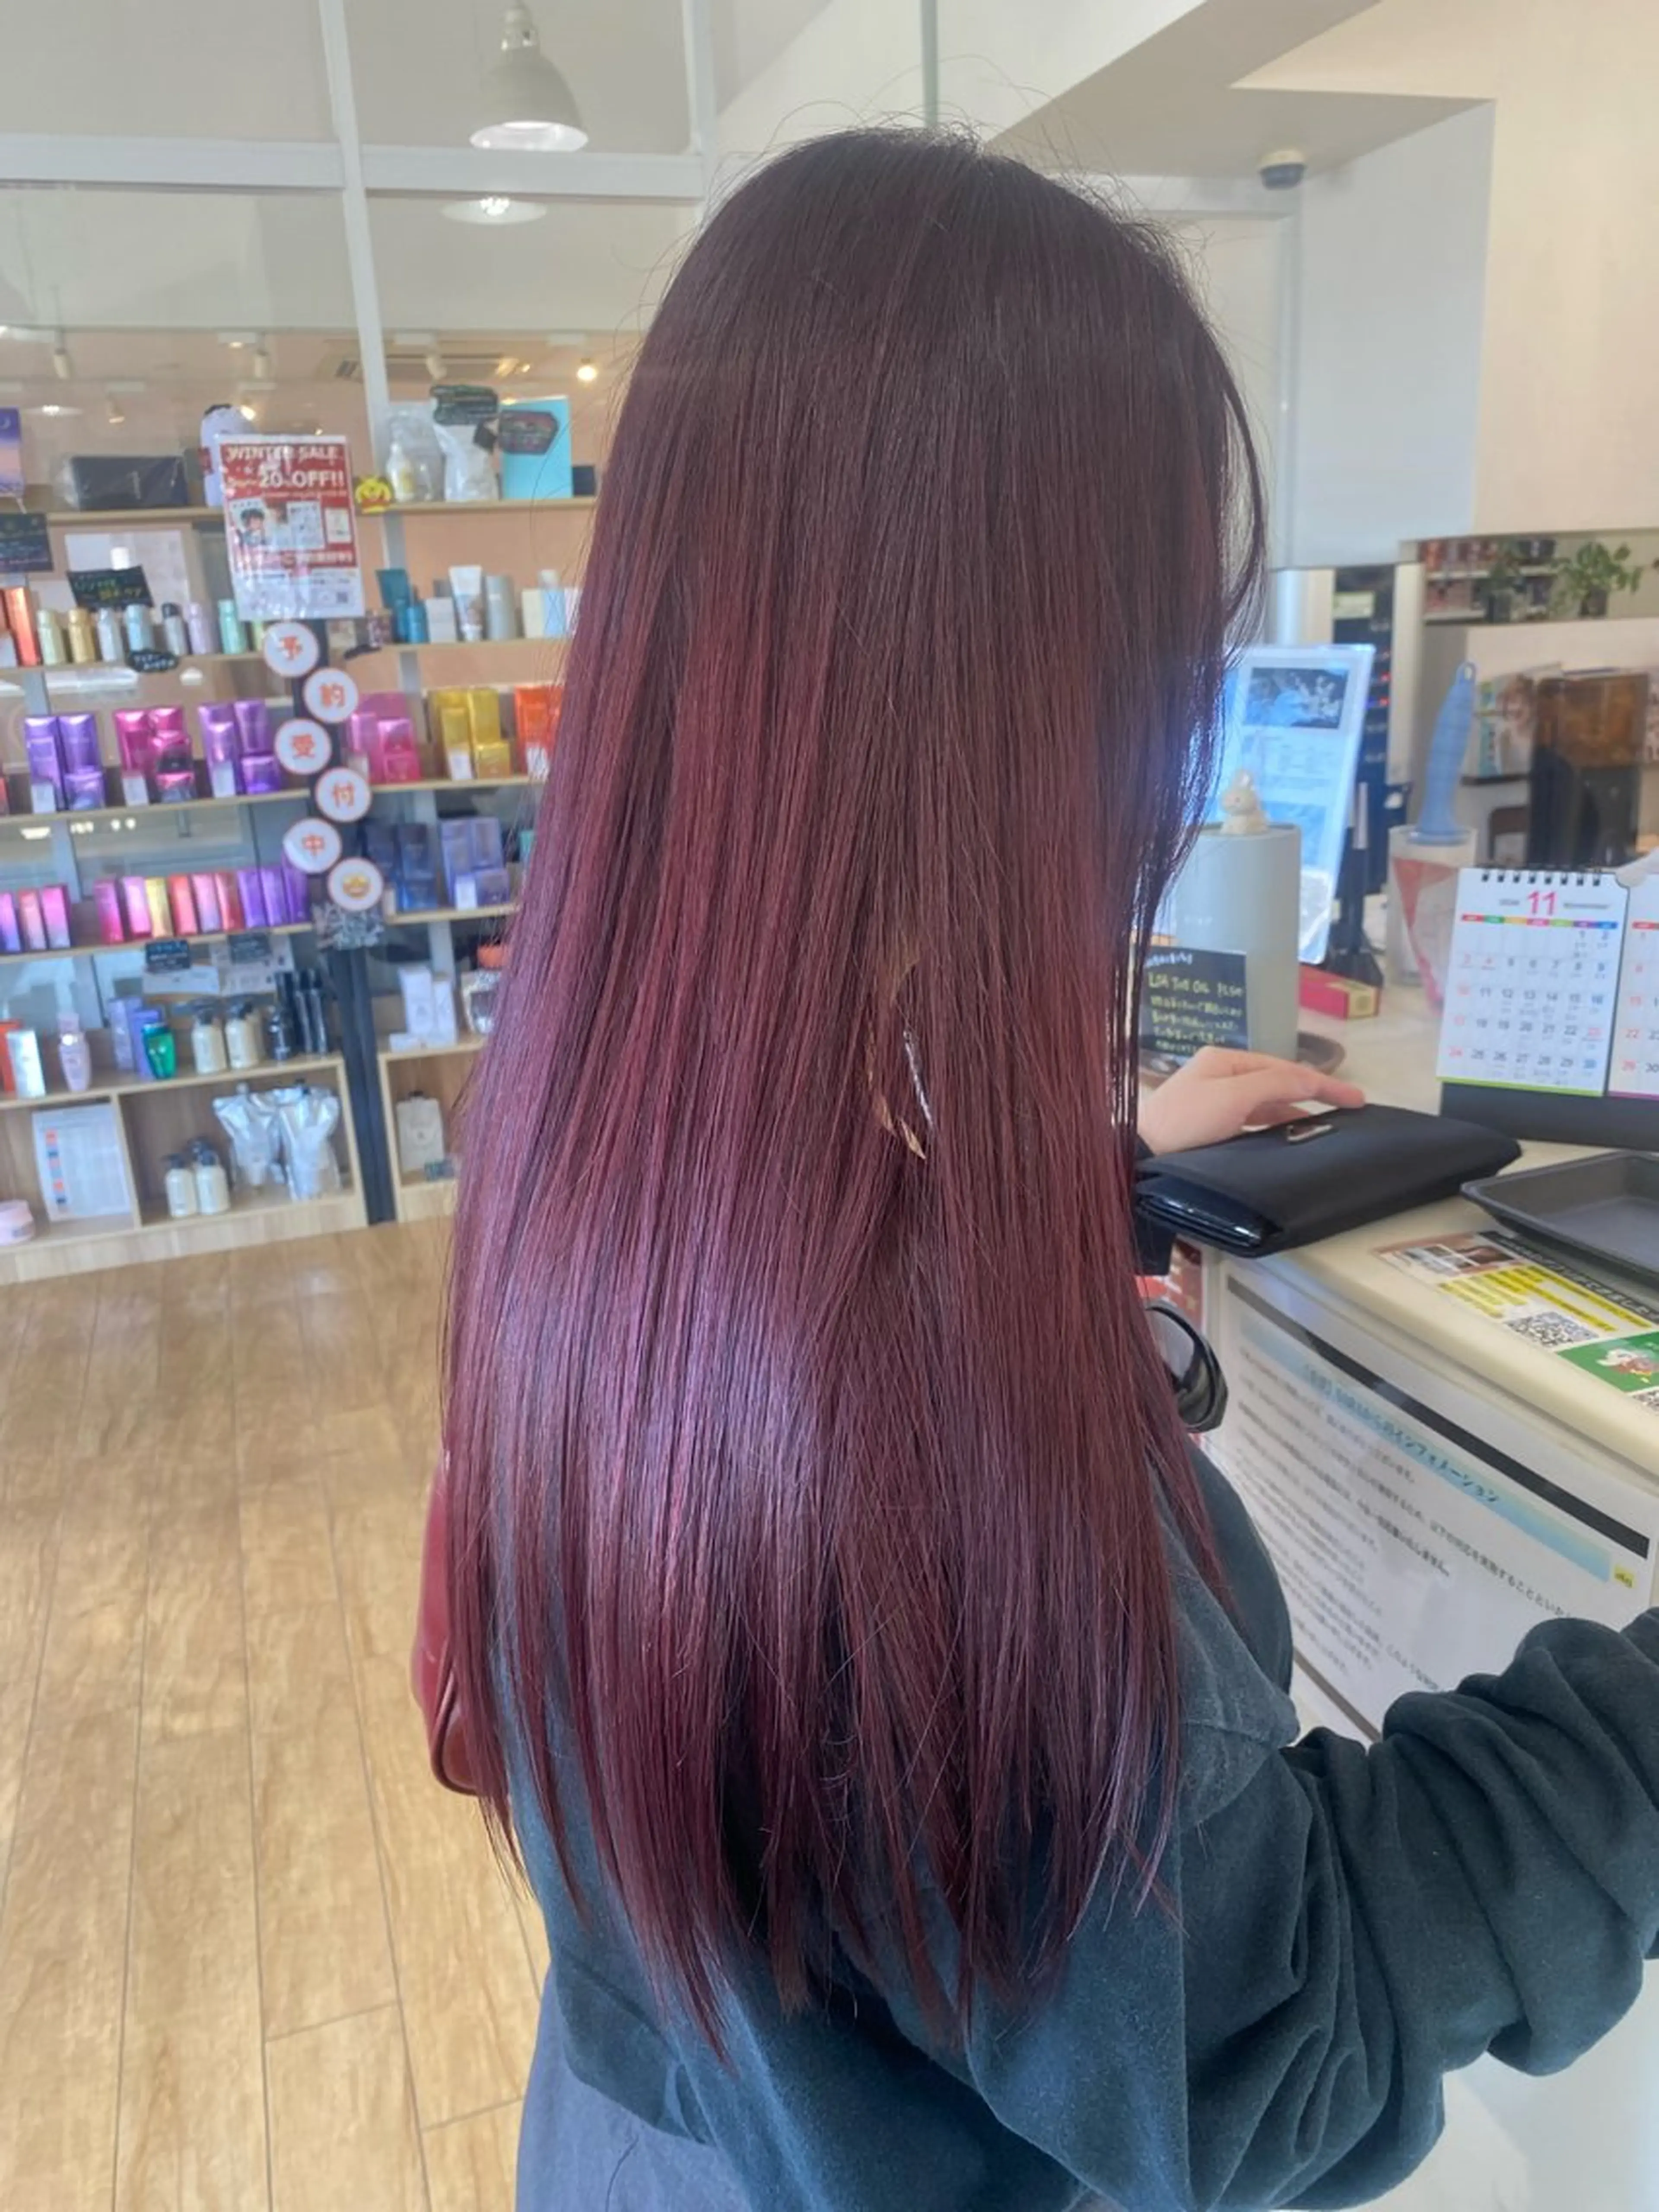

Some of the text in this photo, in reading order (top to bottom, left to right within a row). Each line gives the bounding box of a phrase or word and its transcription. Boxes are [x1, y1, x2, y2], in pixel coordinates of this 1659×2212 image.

[298, 445, 339, 462] SALE
[291, 470, 346, 488] OFF!!
[1527, 890, 1558, 915] 11
